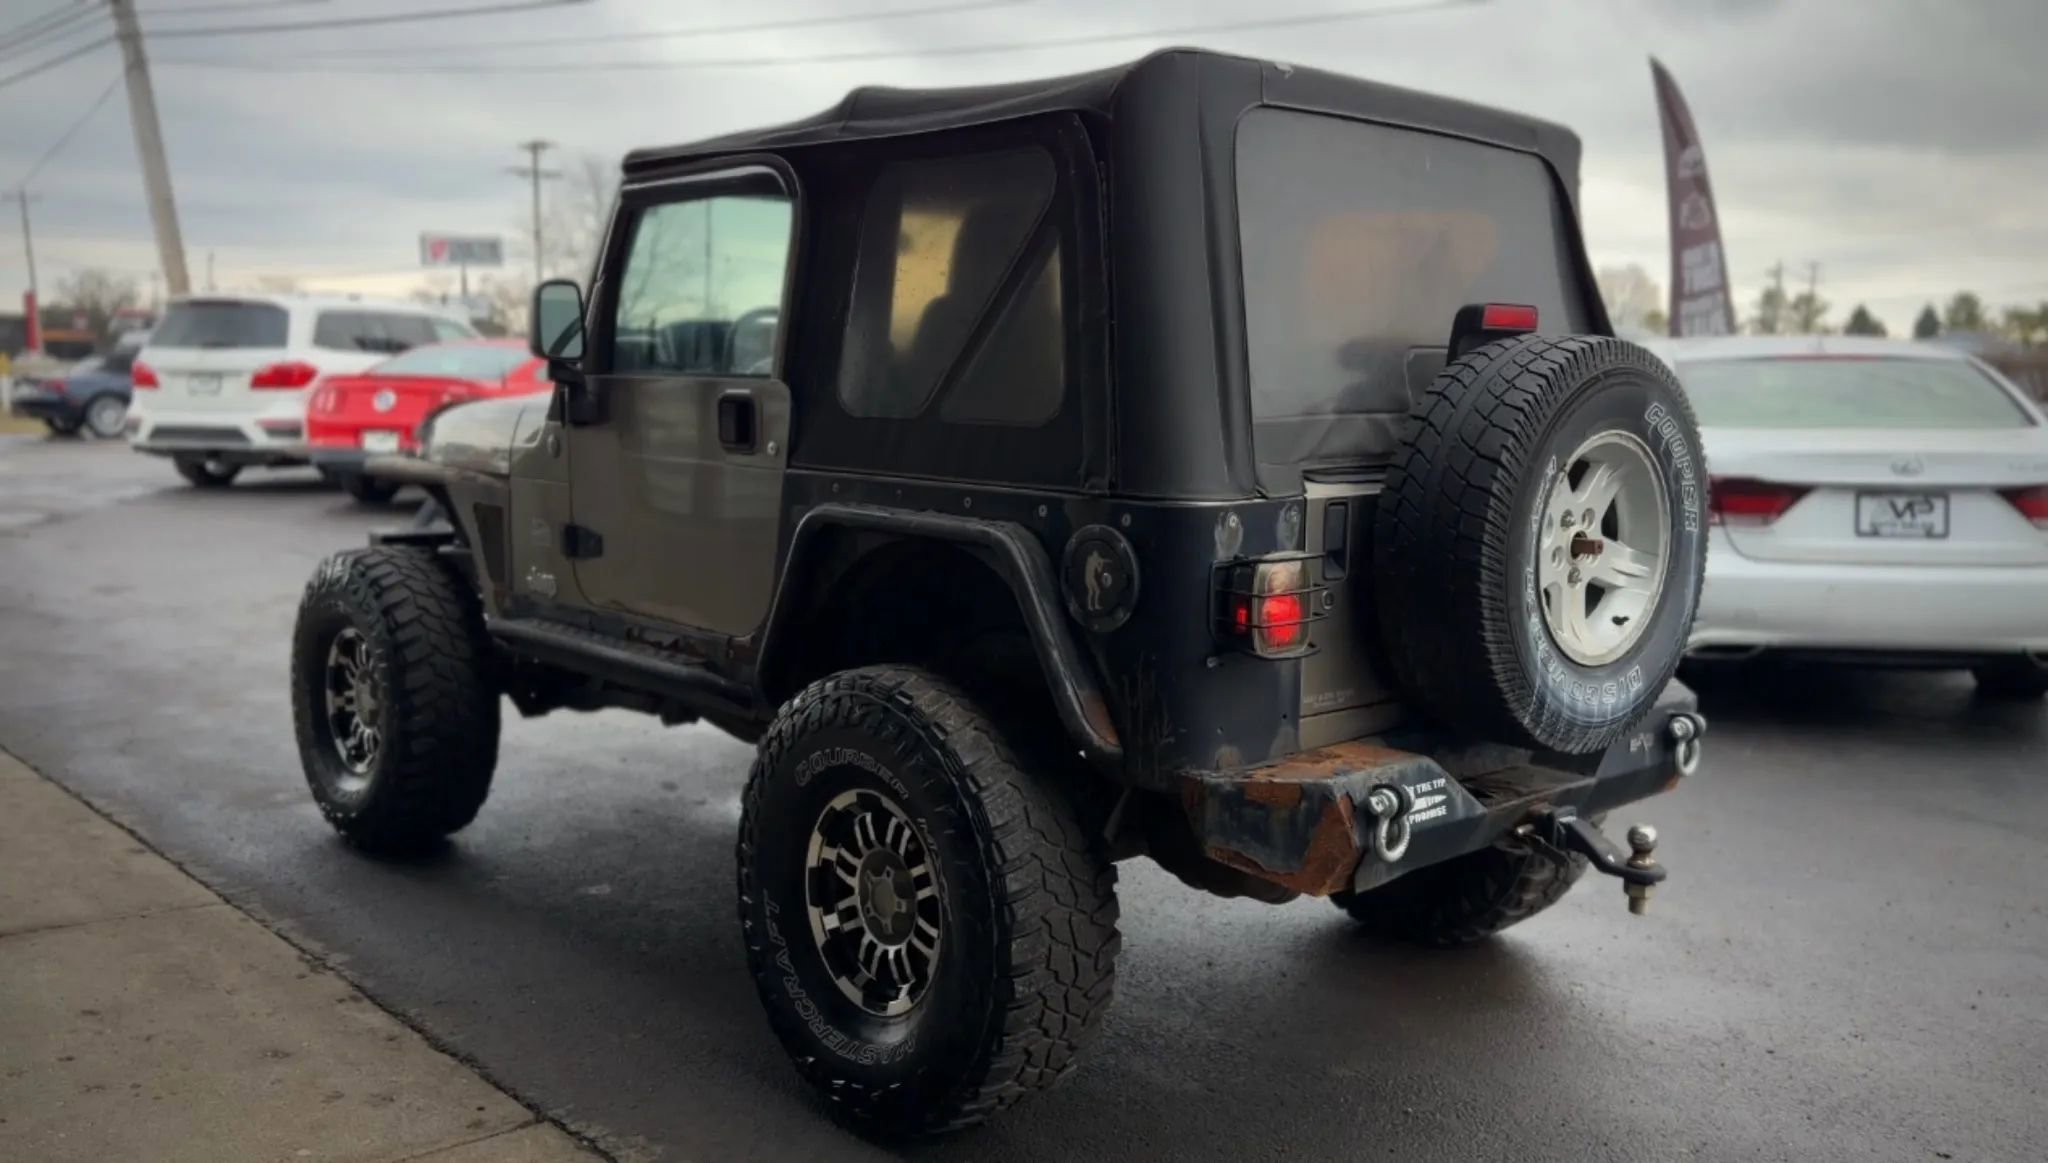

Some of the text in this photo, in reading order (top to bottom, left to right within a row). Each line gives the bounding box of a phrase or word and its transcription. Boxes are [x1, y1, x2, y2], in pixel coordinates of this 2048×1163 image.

[1645, 401, 1698, 533] COOPER
[794, 747, 910, 800] COURSER
[763, 888, 917, 1066] MASTERCRAFT
